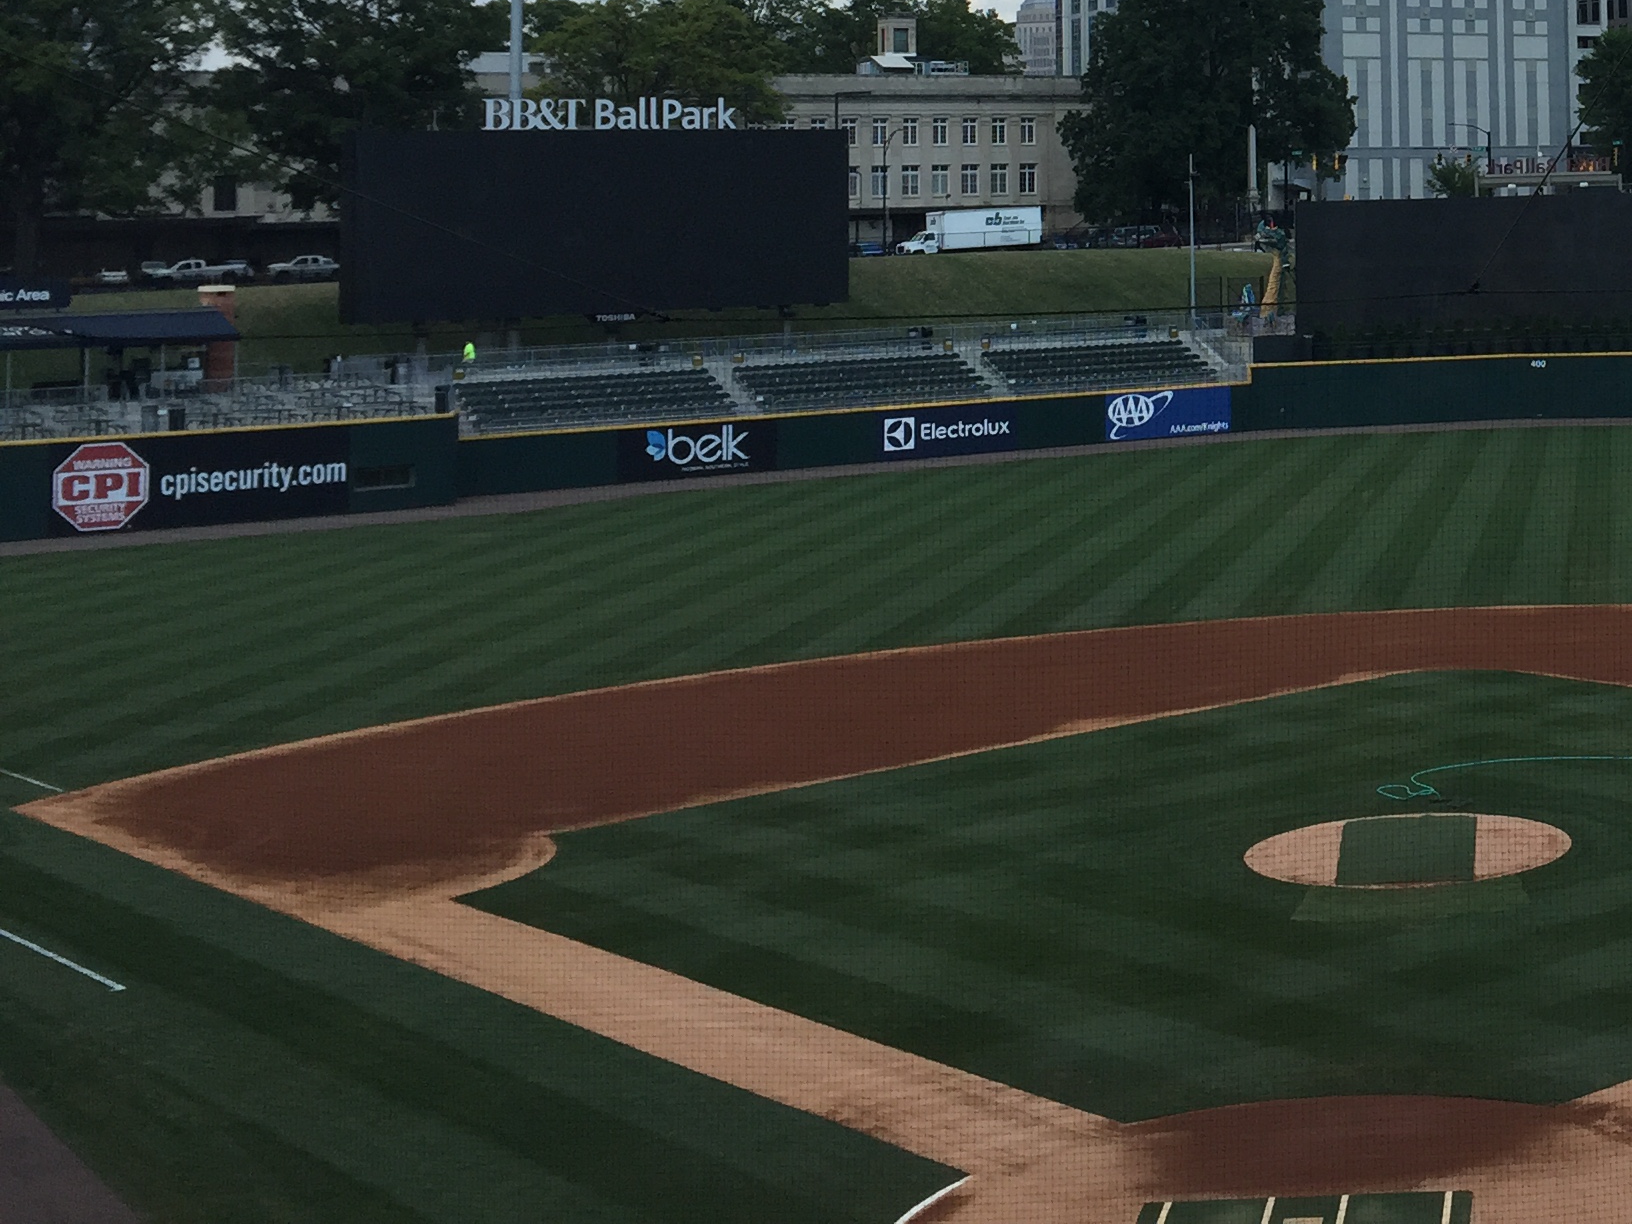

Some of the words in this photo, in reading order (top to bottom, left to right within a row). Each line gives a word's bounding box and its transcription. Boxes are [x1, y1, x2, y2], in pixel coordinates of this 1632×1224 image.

[481, 98, 587, 131] BB&T
[594, 96, 737, 130] BallPark
[15, 288, 51, 302] Area
[595, 313, 636, 322] TOSHIBA
[1530, 359, 1547, 368] 400
[920, 418, 1010, 441] Electrolux
[667, 424, 751, 465] belk
[72, 456, 133, 471] WARNING
[61, 471, 141, 502] CPI
[159, 461, 347, 500] cpisecurity.com
[74, 502, 126, 515] SECURITY
[75, 512, 126, 525] SYSTEMS
